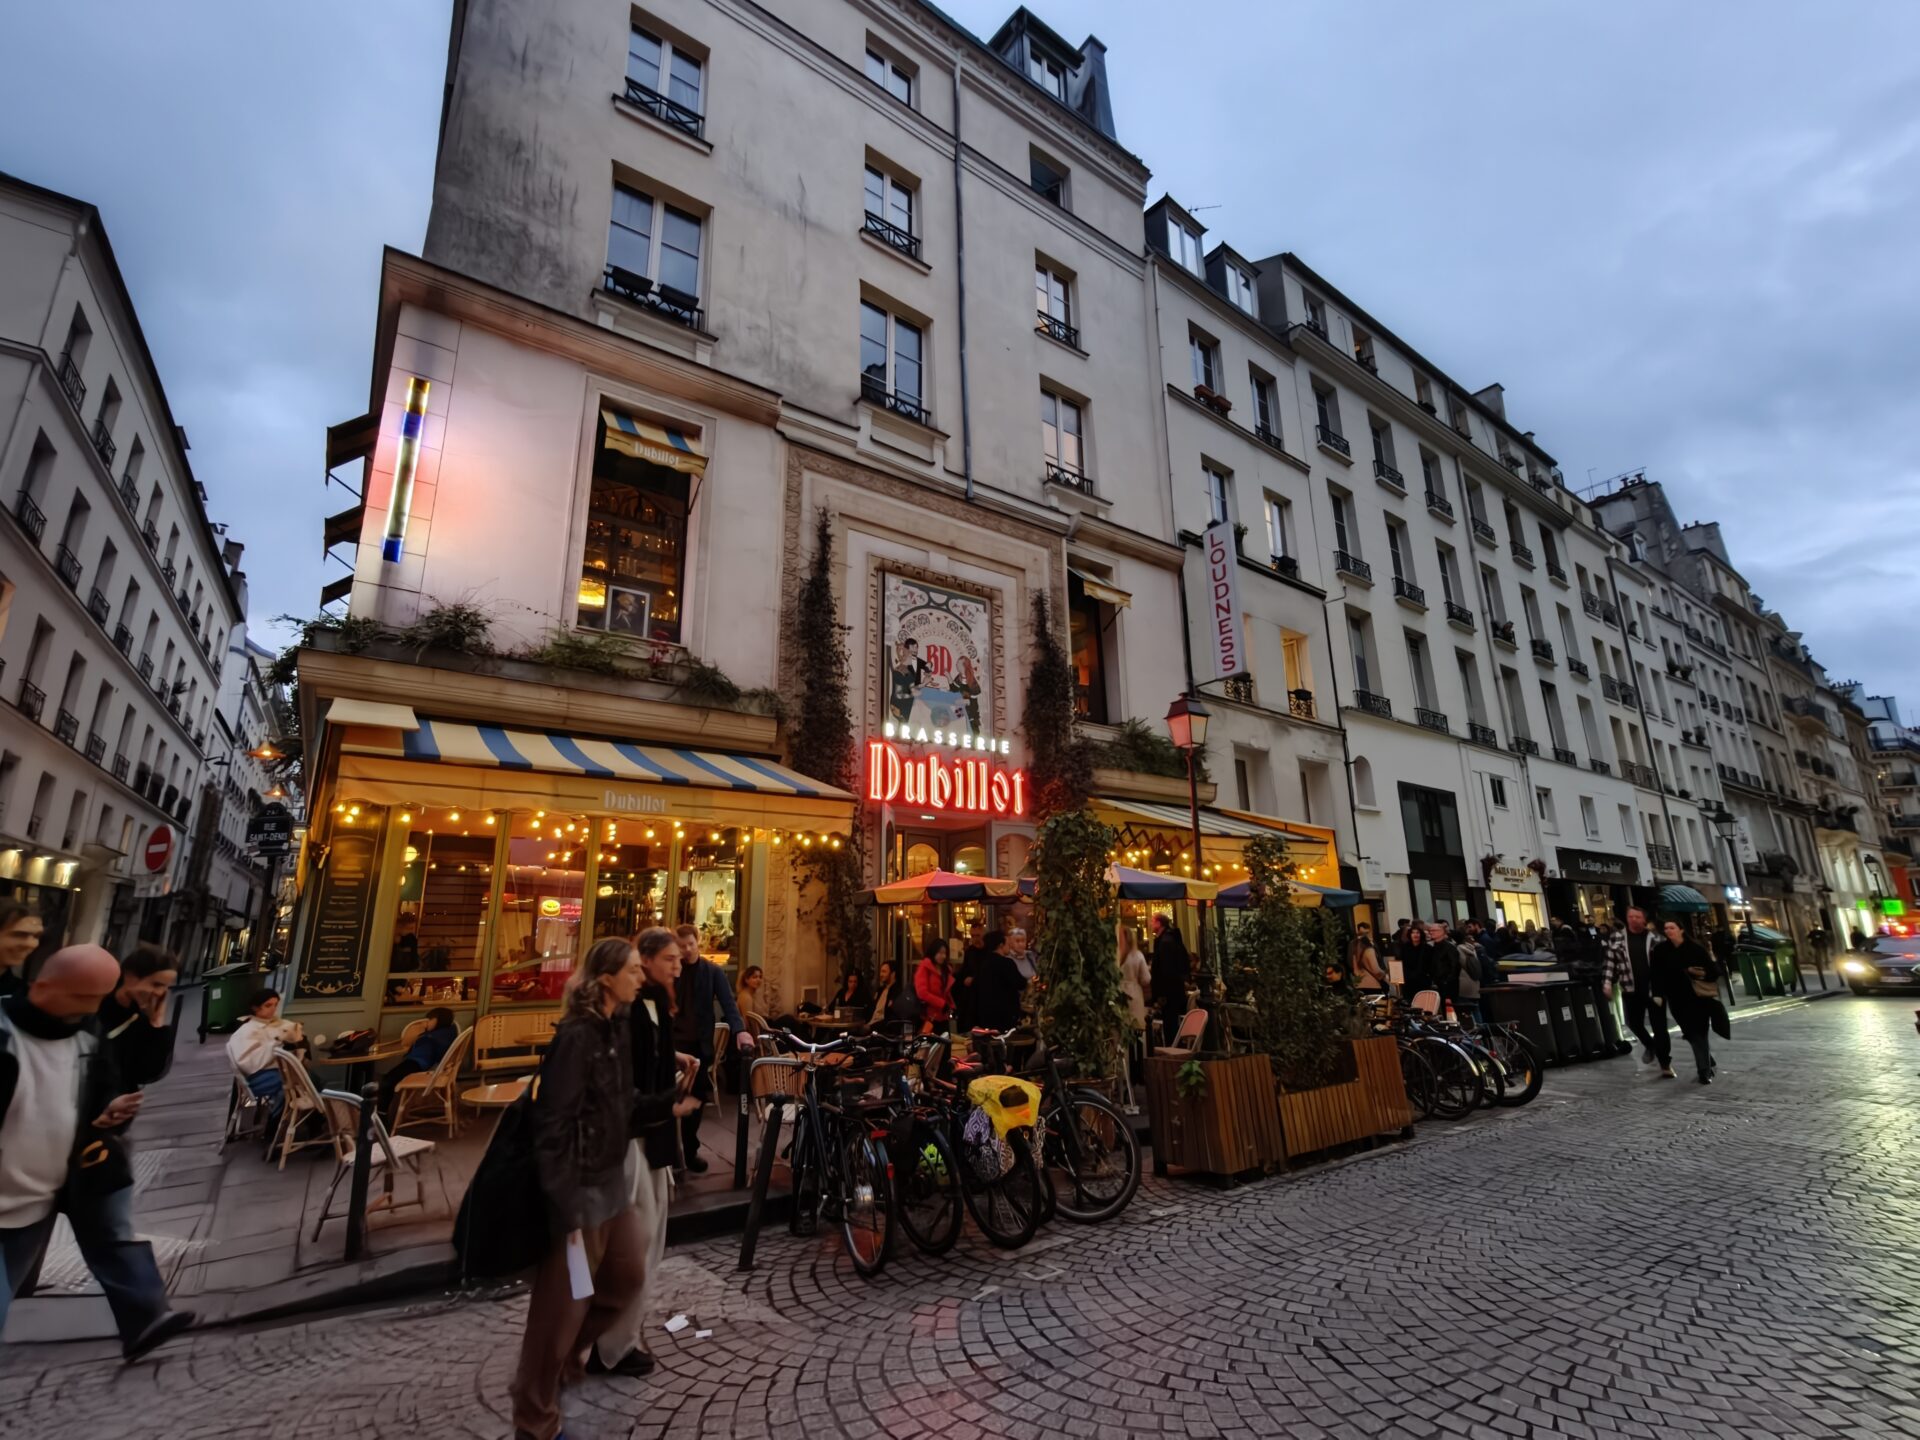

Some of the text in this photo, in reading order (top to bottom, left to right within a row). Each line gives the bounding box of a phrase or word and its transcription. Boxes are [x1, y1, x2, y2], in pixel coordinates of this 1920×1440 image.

[634, 441, 680, 466] Dubillot
[1209, 533, 1236, 672] LOUDNESS
[884, 722, 1011, 755] BRASSERIE
[867, 740, 1025, 816] Dubillot
[604, 790, 666, 812] Dubillot
[249, 833, 288, 841] SAINT-DENIS
[263, 822, 277, 831] RUE
